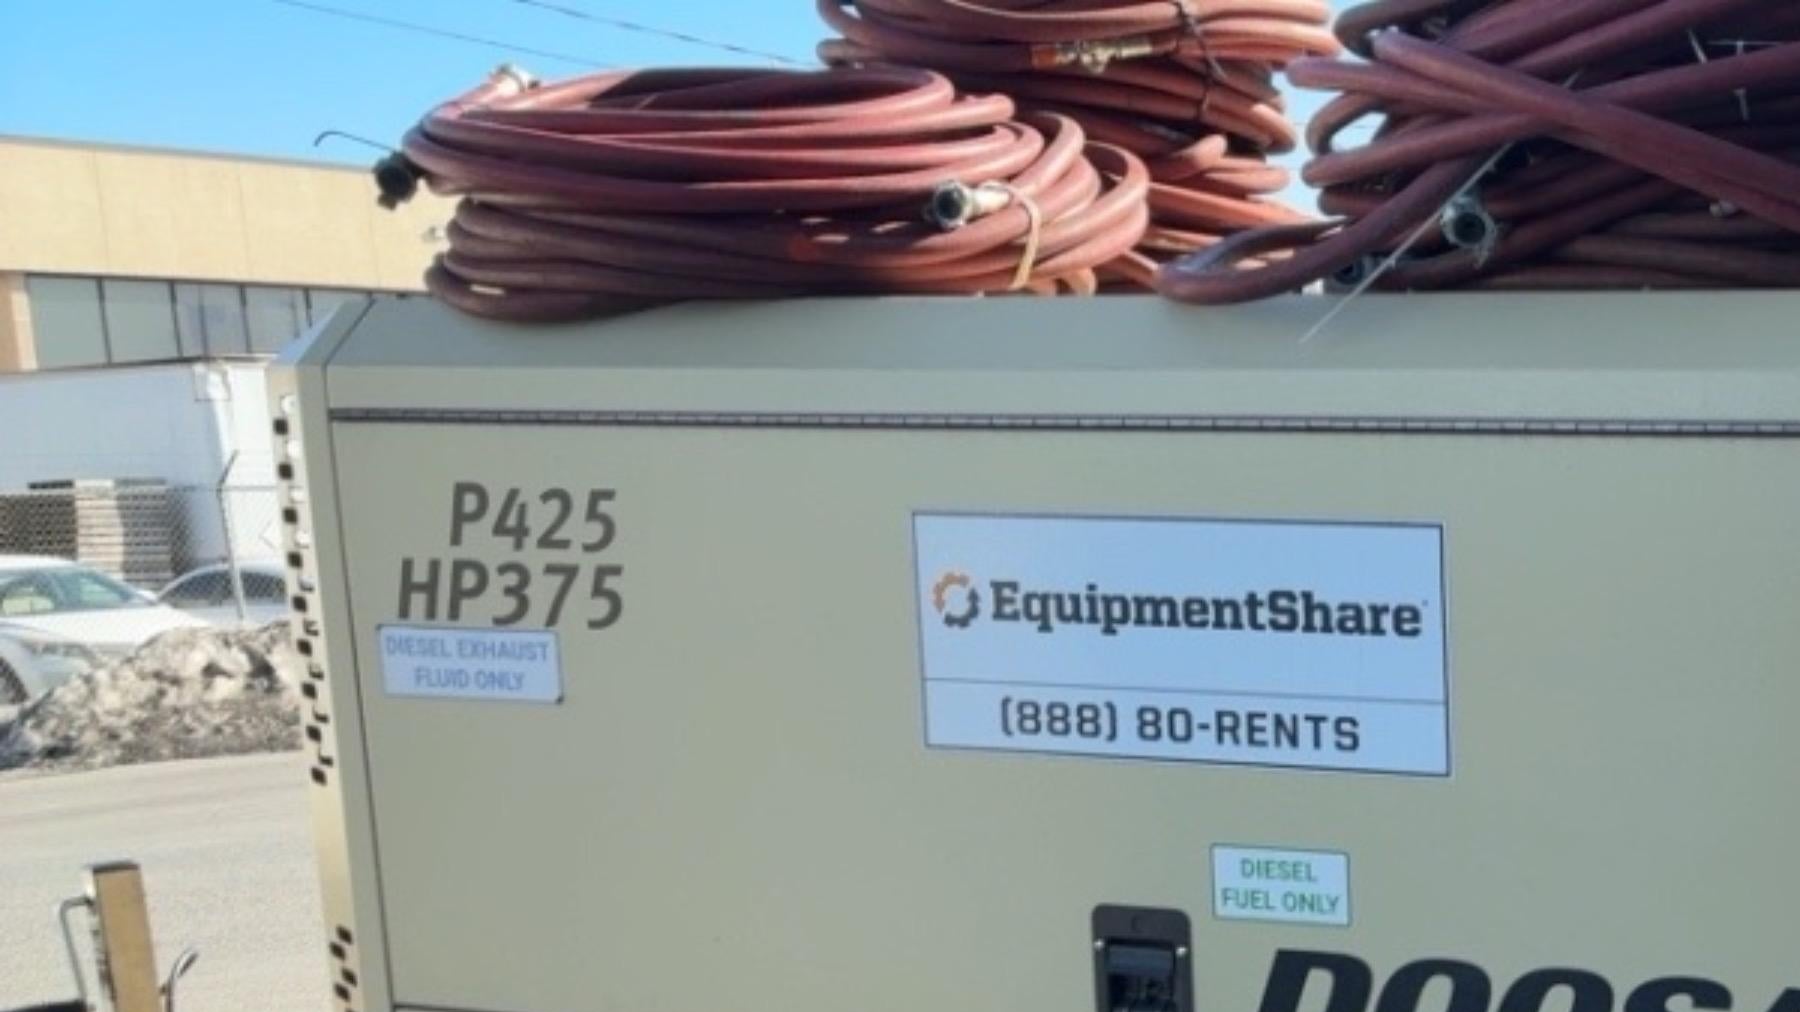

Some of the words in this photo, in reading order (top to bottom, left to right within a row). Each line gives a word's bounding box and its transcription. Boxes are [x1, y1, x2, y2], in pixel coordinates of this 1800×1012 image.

[449, 481, 617, 553] P425
[397, 558, 624, 630] HP375
[989, 581, 1423, 638] EquipmentShare
[386, 636, 452, 659] DIESEL
[456, 638, 548, 663] EXHAUST
[414, 666, 470, 688] FLUID
[474, 669, 526, 691] ONLY
[1000, 696, 1118, 742] (888)
[1136, 706, 1360, 752] 80-RENTS
[1239, 857, 1318, 883] DIESEL
[1220, 887, 1276, 911] FUEL
[1282, 891, 1341, 915] ONLY
